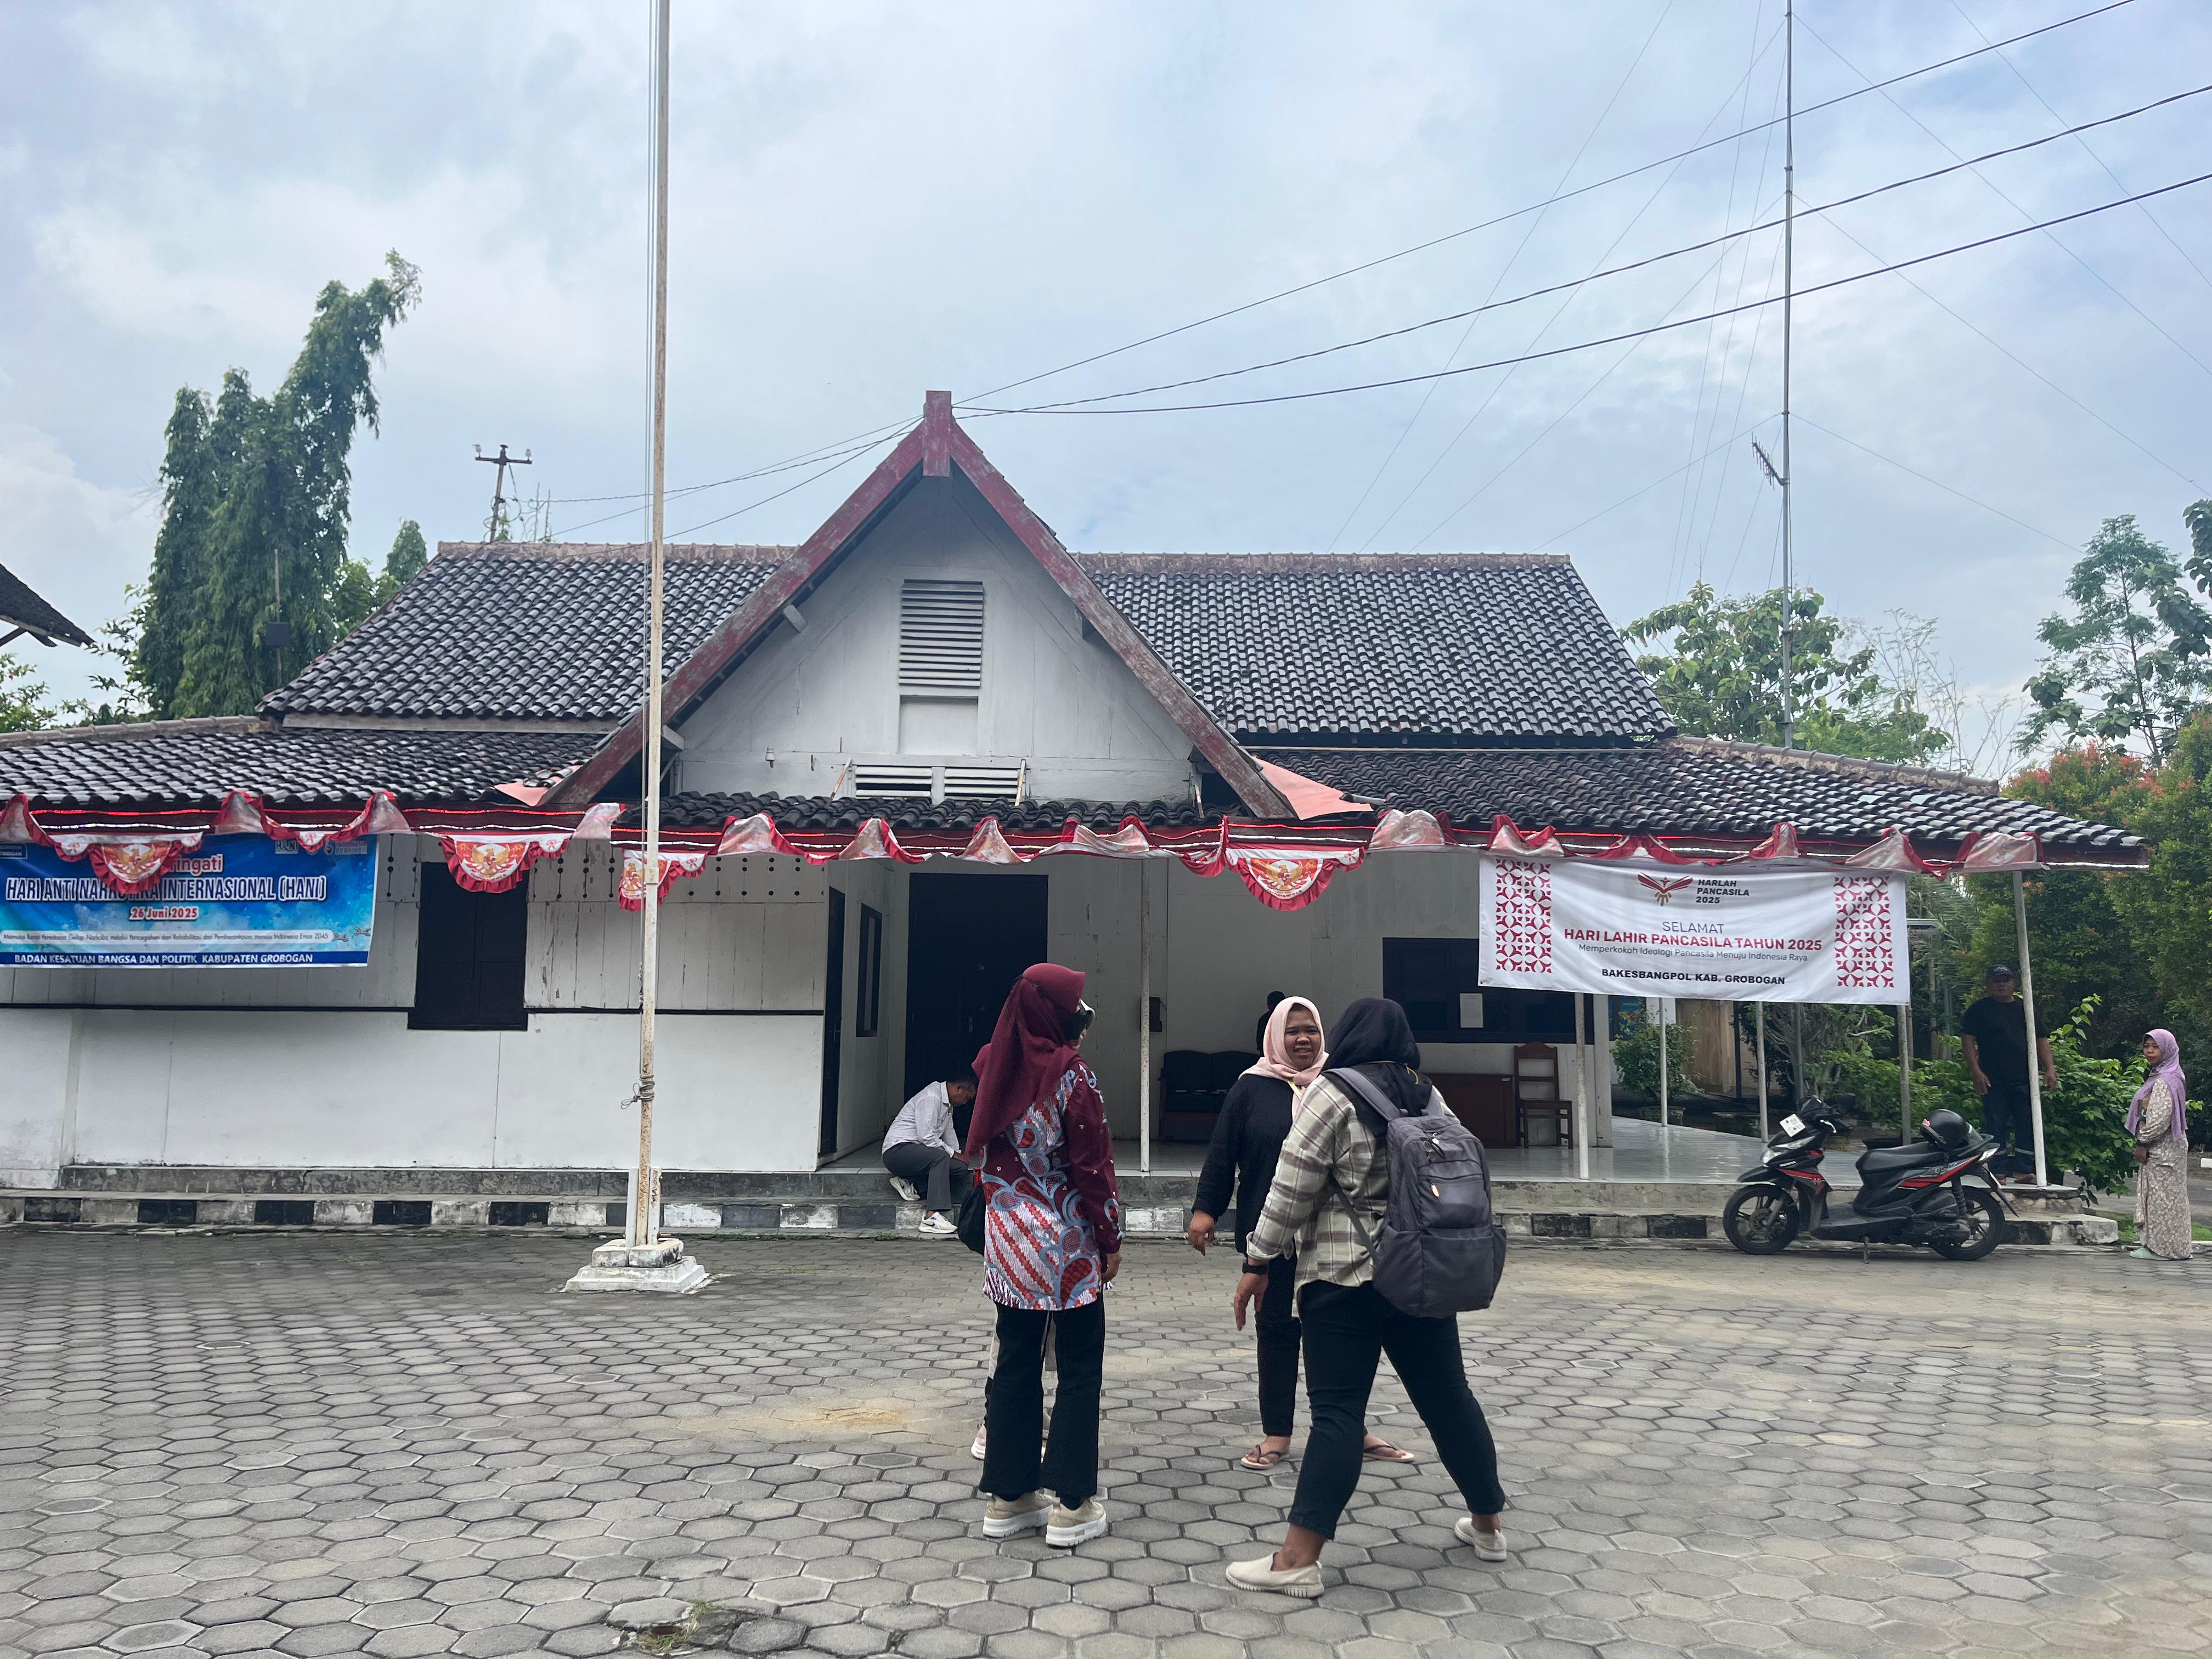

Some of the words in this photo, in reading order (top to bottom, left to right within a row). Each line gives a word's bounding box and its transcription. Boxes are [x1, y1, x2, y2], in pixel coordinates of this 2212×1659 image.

[7, 878, 40, 900] HARI
[43, 878, 77, 900] ANTI
[163, 878, 276, 900] INTERNASIONAL
[279, 876, 326, 901] (HANI)
[1697, 888, 1750, 896] PANCASILA
[131, 908, 144, 918] 26
[146, 907, 168, 918] Juni
[172, 907, 198, 918] 2025
[1662, 921, 1724, 934] SELAMAT
[1564, 928, 1600, 941] HARI
[1604, 930, 1647, 944] LAHIR
[1651, 934, 1733, 948] PANCASILA
[1735, 938, 1784, 950] TAHUN
[1788, 939, 1822, 951] 2025
[15, 954, 47, 963] BADAN
[49, 955, 95, 963] KESATUAN
[98, 955, 137, 963] BANGSA
[139, 955, 160, 964] DAN
[161, 955, 198, 964] POLITIK
[202, 954, 258, 964] KABUPATEN
[260, 953, 313, 963] GROBOGAN
[1579, 944, 1638, 955] Memperkokoh
[1640, 947, 1673, 957] Ideologi
[1675, 949, 1714, 957] Pancasila
[1717, 951, 1746, 960] Menuju
[1748, 952, 1787, 961] Indonesia
[1789, 953, 1808, 962] Raya
[1601, 968, 1692, 980] BAKESBANGPOL
[1695, 973, 1721, 982] KAB.
[1725, 974, 1785, 984] GROBOGAN
